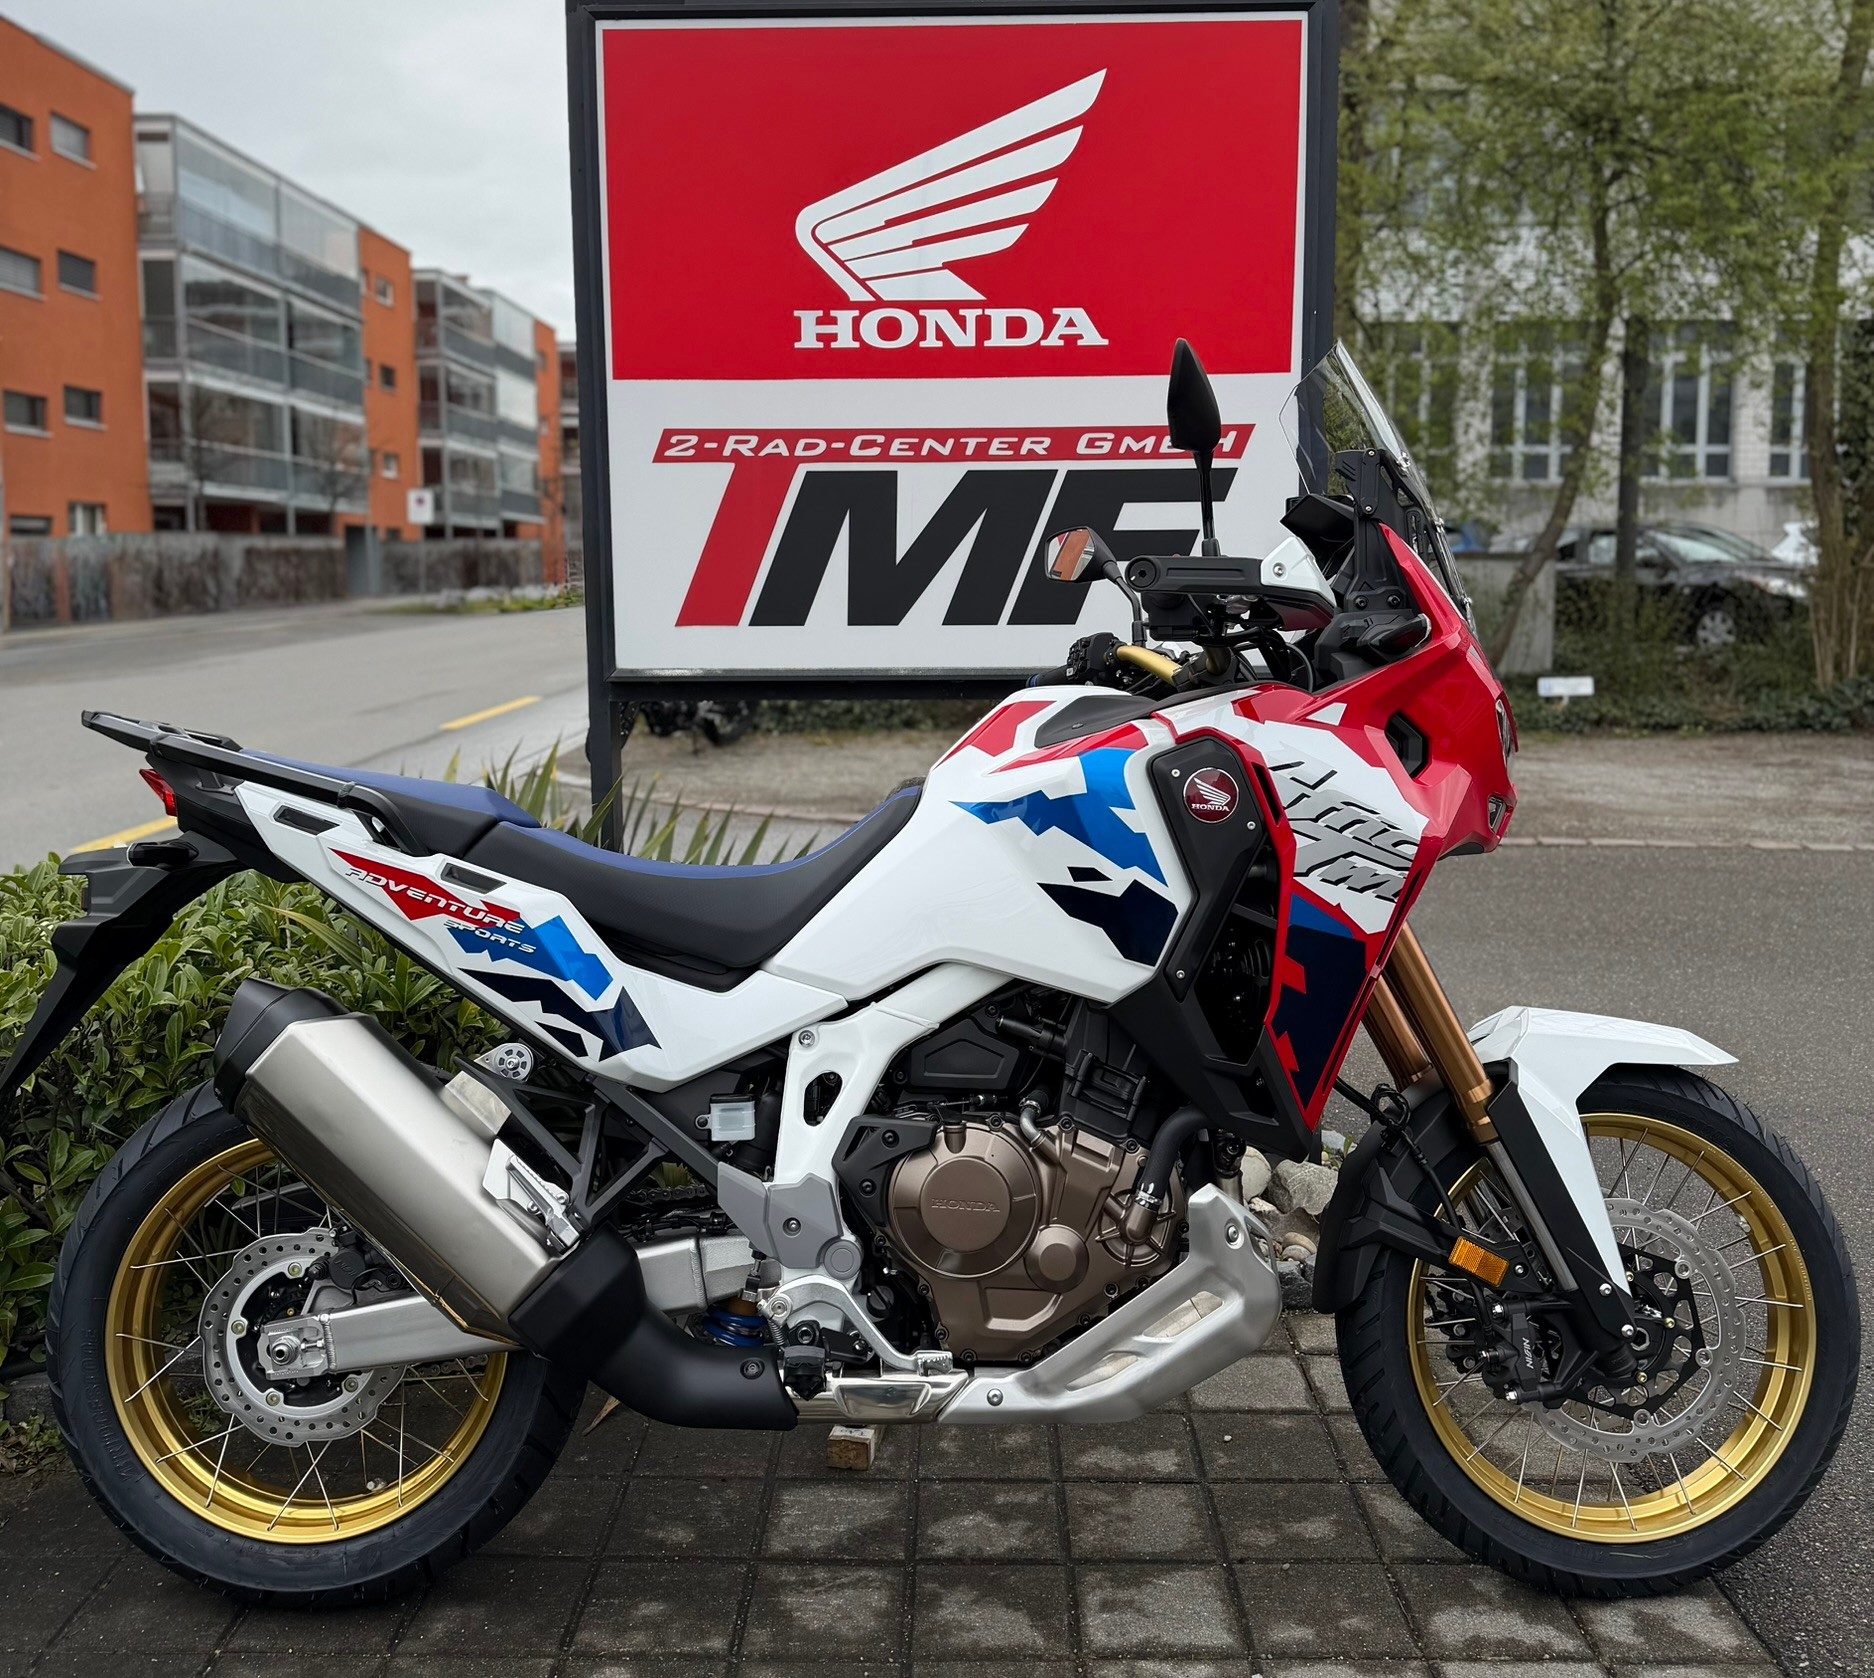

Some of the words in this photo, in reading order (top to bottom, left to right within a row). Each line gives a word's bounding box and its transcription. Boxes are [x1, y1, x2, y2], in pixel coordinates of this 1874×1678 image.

[793, 307, 1109, 349] HONDA
[675, 461, 1239, 627] TMF
[1191, 803, 1230, 812] HONDA
[345, 867, 525, 935] ADVENTURE
[443, 918, 537, 955] SPORTS
[931, 1198, 1001, 1213] HONDA
